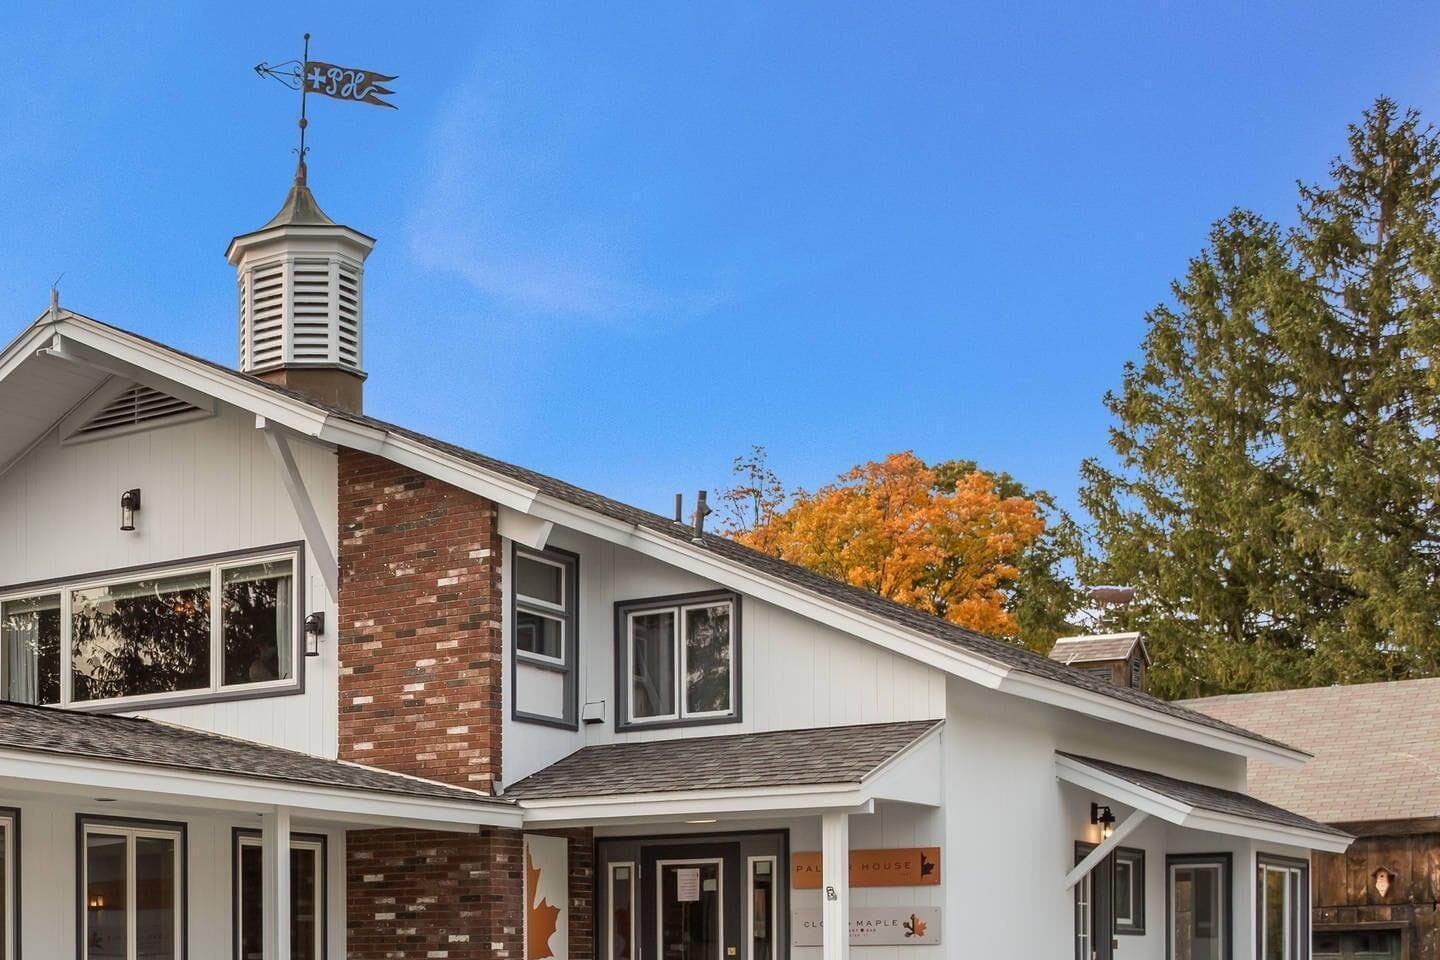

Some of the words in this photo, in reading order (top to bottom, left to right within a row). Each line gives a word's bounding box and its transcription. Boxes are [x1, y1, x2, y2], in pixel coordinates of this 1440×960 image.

[796, 863, 852, 873] PAL
[862, 861, 912, 871] HOUSE
[856, 919, 898, 927] MAPLE
